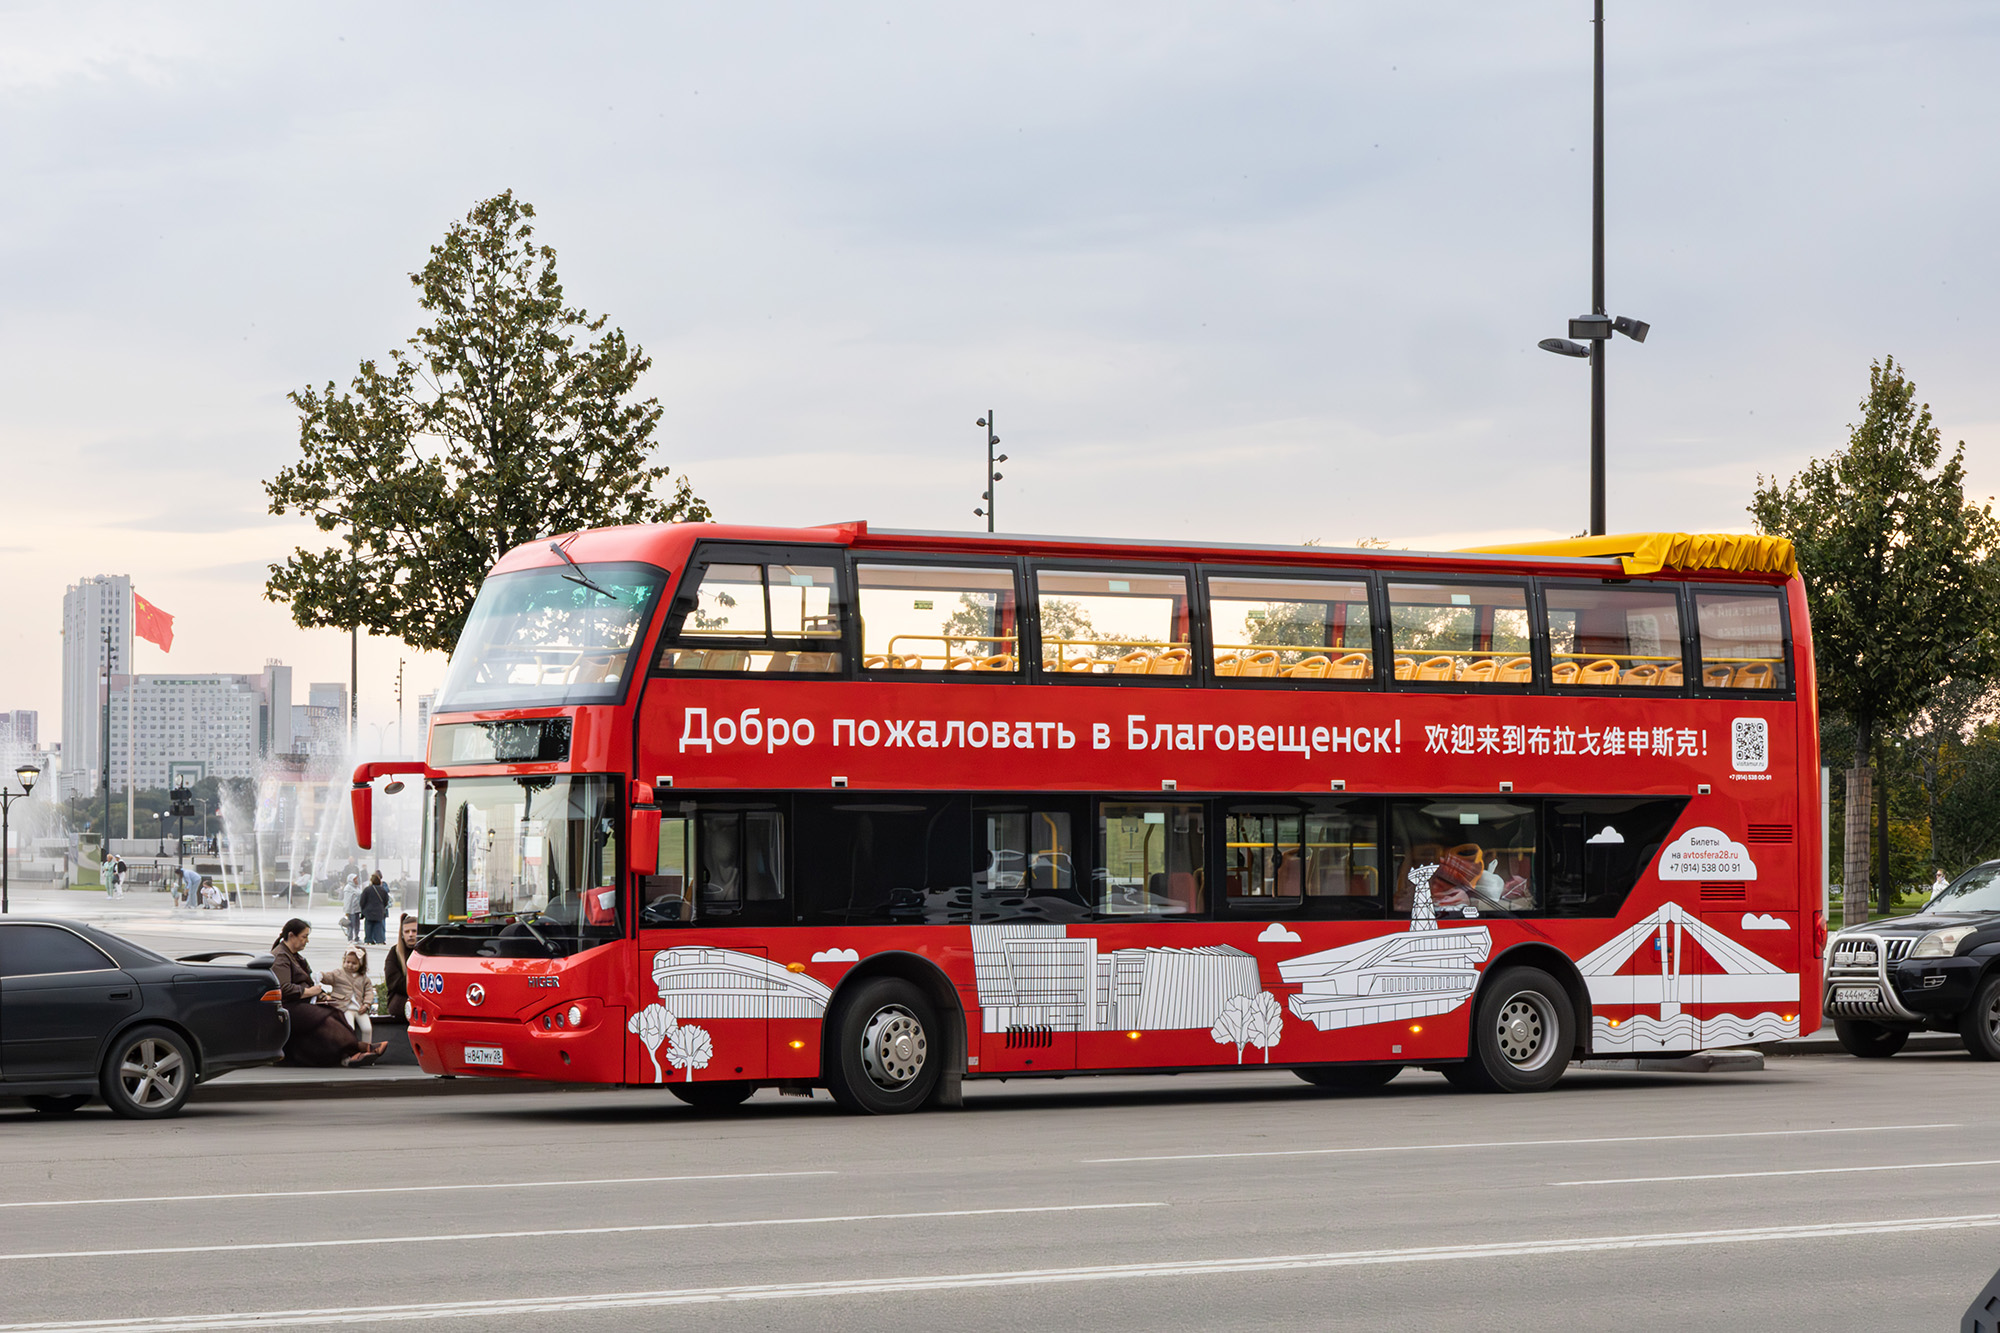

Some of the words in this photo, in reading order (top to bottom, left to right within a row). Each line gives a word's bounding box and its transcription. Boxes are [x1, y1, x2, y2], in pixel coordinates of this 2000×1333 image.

[678, 707, 816, 754] Добро
[832, 718, 1076, 750] пожаловать
[1092, 722, 1111, 750] в
[1127, 714, 1401, 760] Благовещенск!
[1690, 837, 1720, 847] Билеты
[1683, 850, 1739, 859] avtosfera28.ru
[1670, 863, 1679, 873] +7
[1680, 863, 1700, 874] (914)
[1702, 863, 1717, 873] 538
[1718, 863, 1730, 873] 00
[1731, 863, 1741, 873] 91
[527, 975, 560, 988] HIGER
